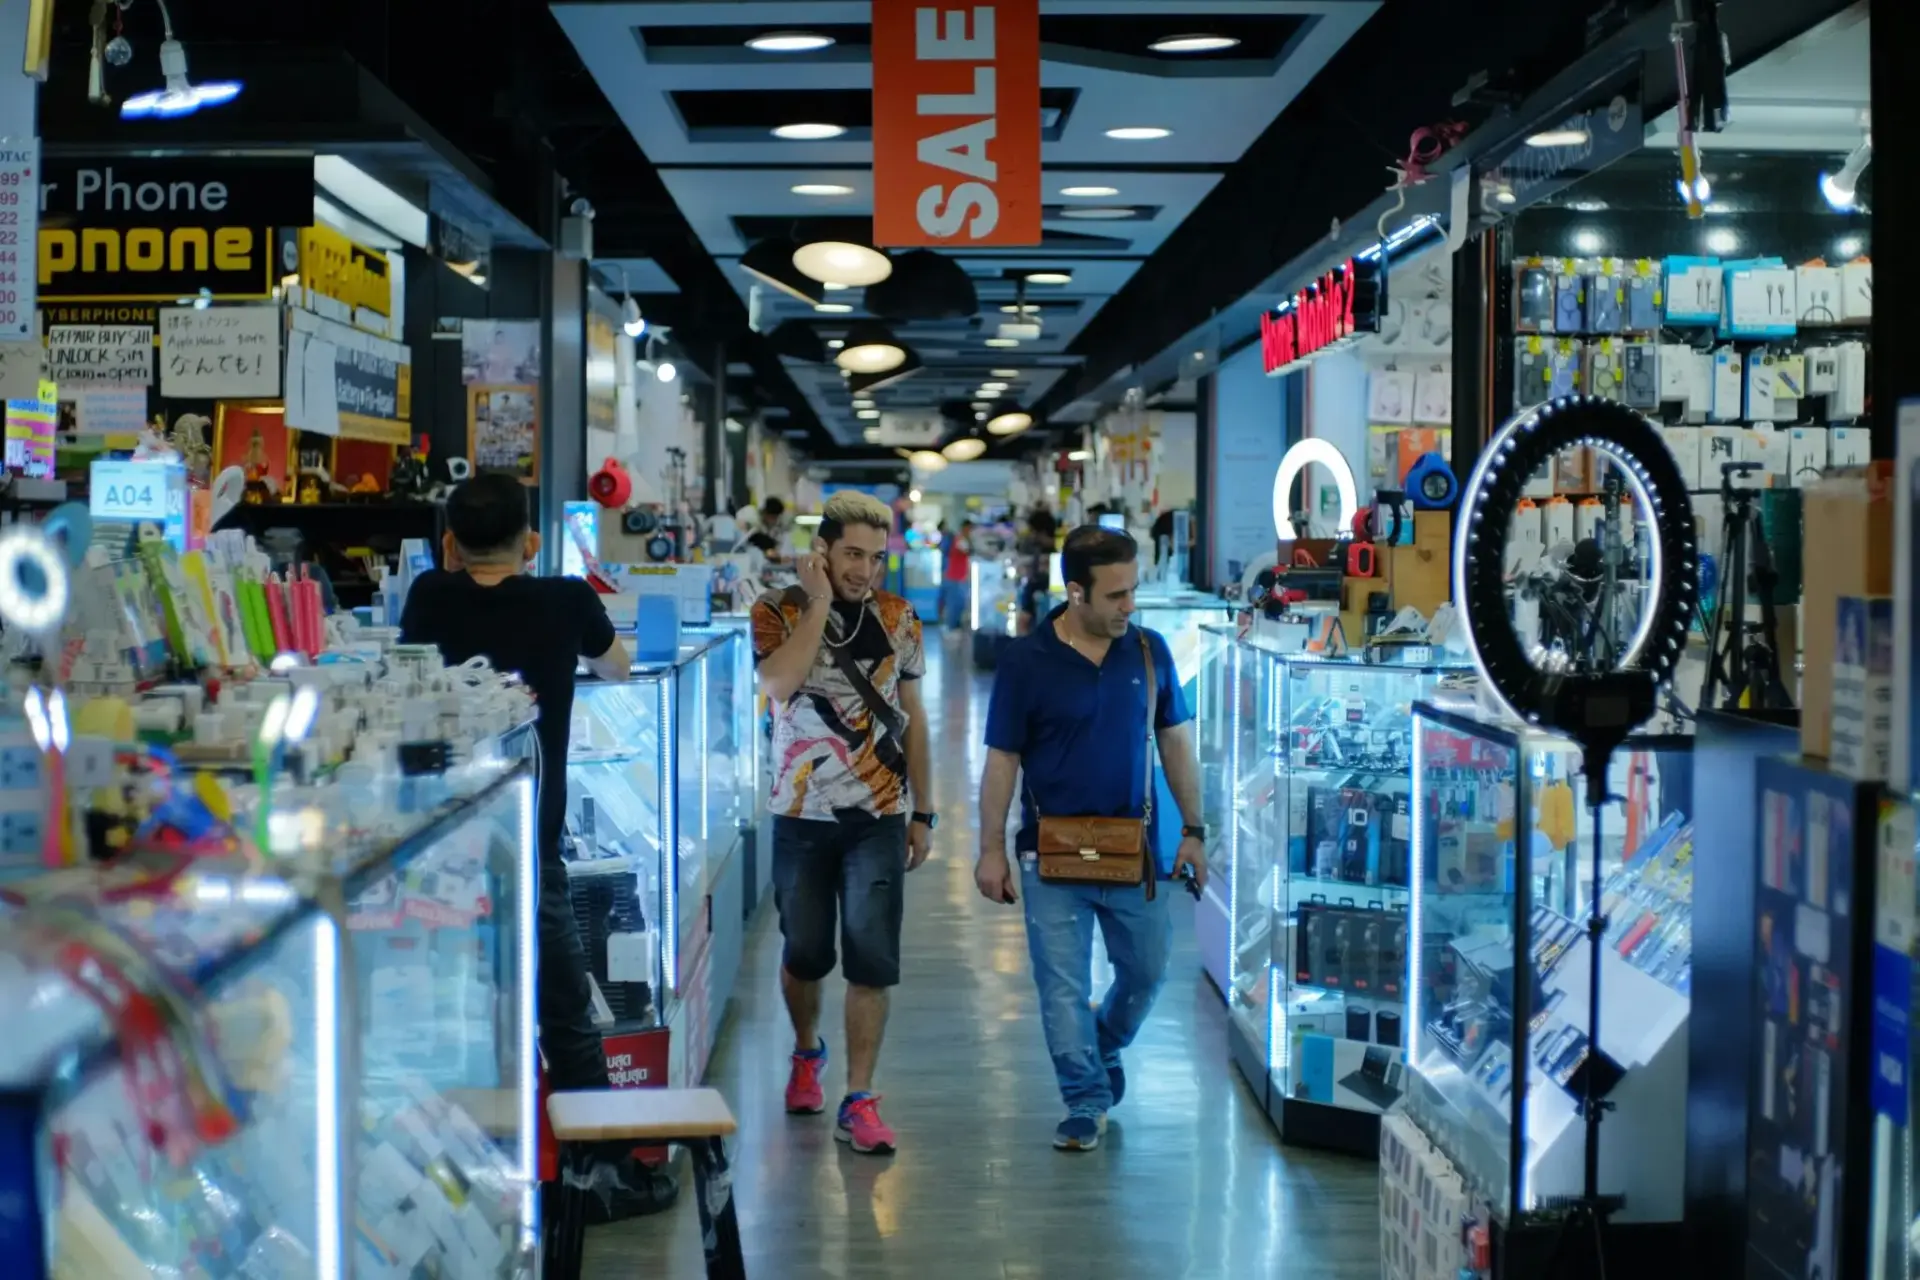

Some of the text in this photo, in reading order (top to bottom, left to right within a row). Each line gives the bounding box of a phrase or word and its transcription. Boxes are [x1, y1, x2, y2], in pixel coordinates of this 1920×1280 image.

[915, 6, 1000, 240] SALE
[76, 166, 228, 212] Phone
[98, 329, 126, 346] BUY
[49, 348, 110, 366] UNLOCK
[1347, 807, 1368, 826] 10
